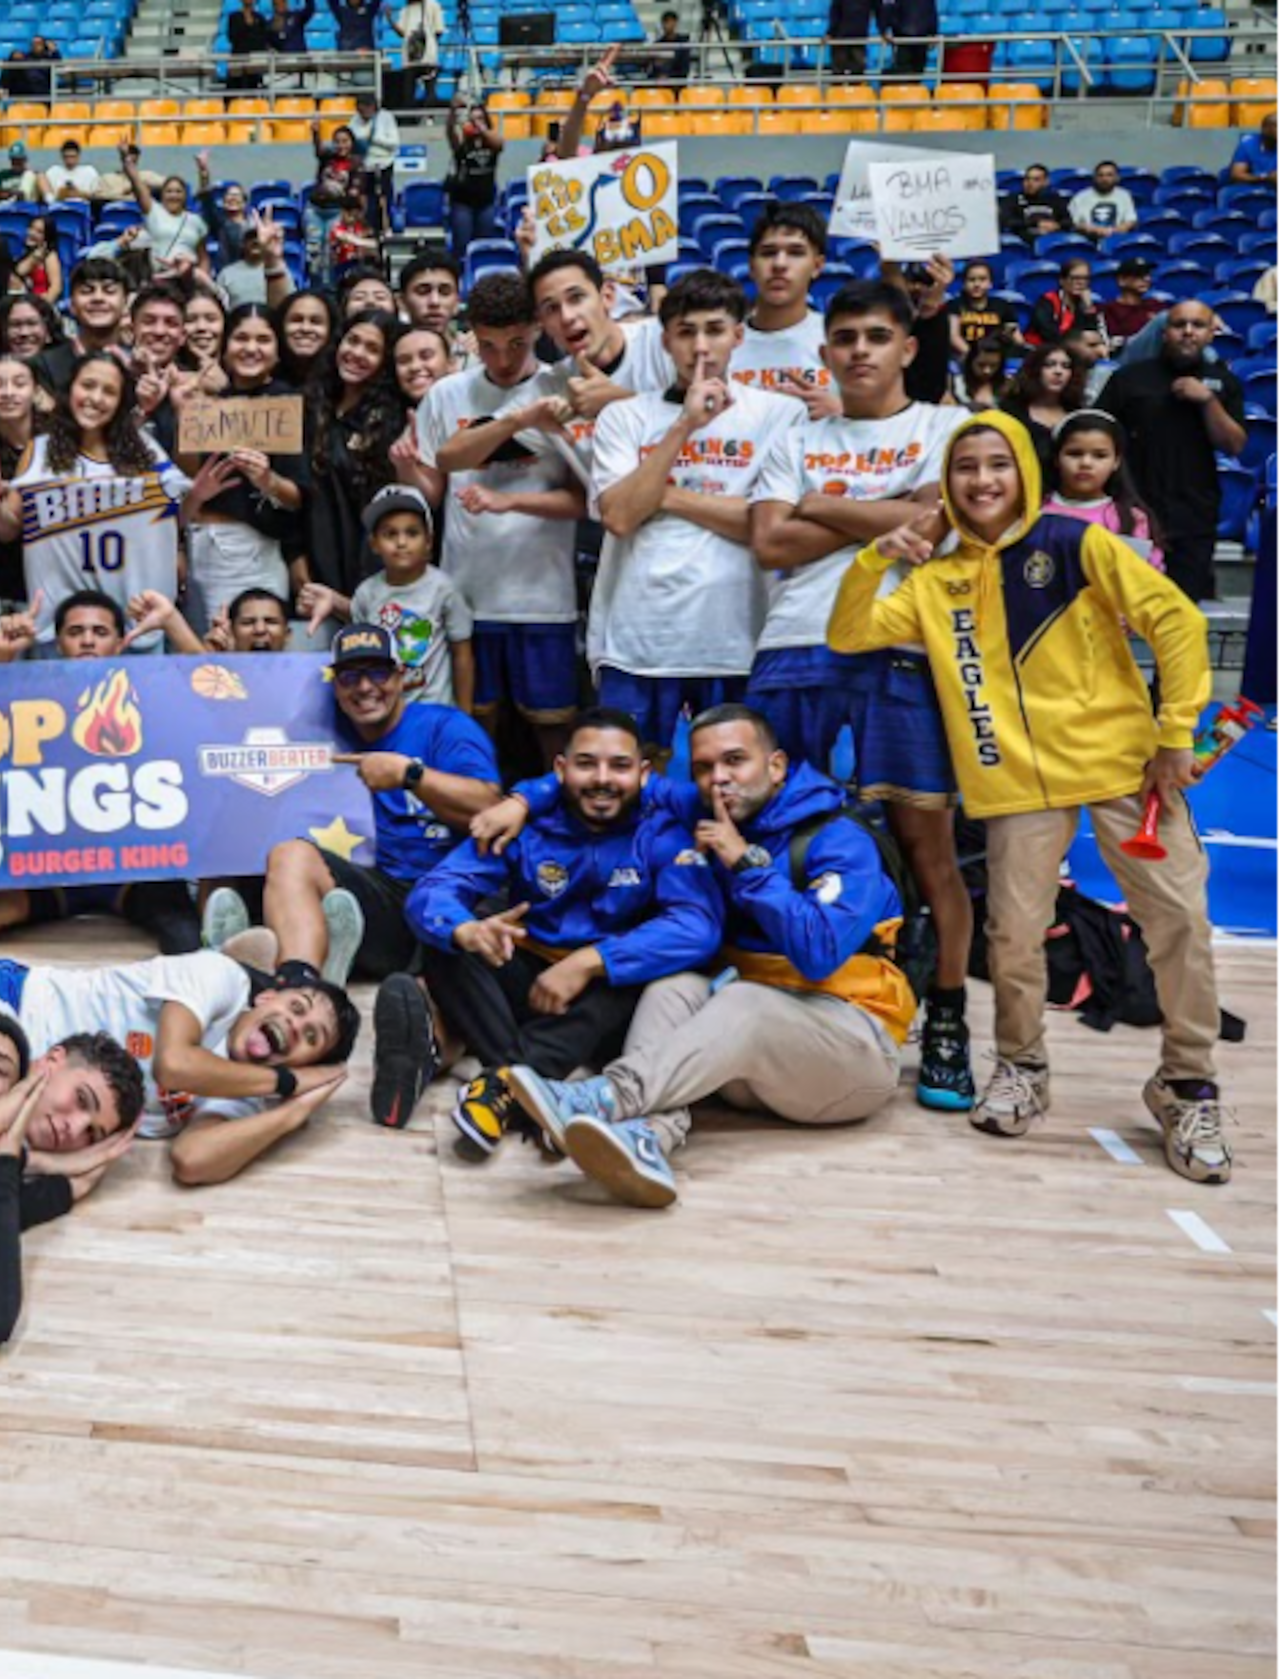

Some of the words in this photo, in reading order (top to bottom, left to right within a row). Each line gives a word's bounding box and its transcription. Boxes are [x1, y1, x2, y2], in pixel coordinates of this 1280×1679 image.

[621, 151, 670, 212] O
[886, 167, 951, 199] BMA
[594, 209, 676, 264] BMA
[880, 204, 967, 236] VAMOS
[34, 477, 146, 529] BMA
[79, 530, 125, 573] 10
[951, 607, 1002, 768] EAGLES
[206, 748, 327, 770] BUZZERBEATER
[8, 848, 115, 878] BURGER
[121, 843, 189, 869] KING
